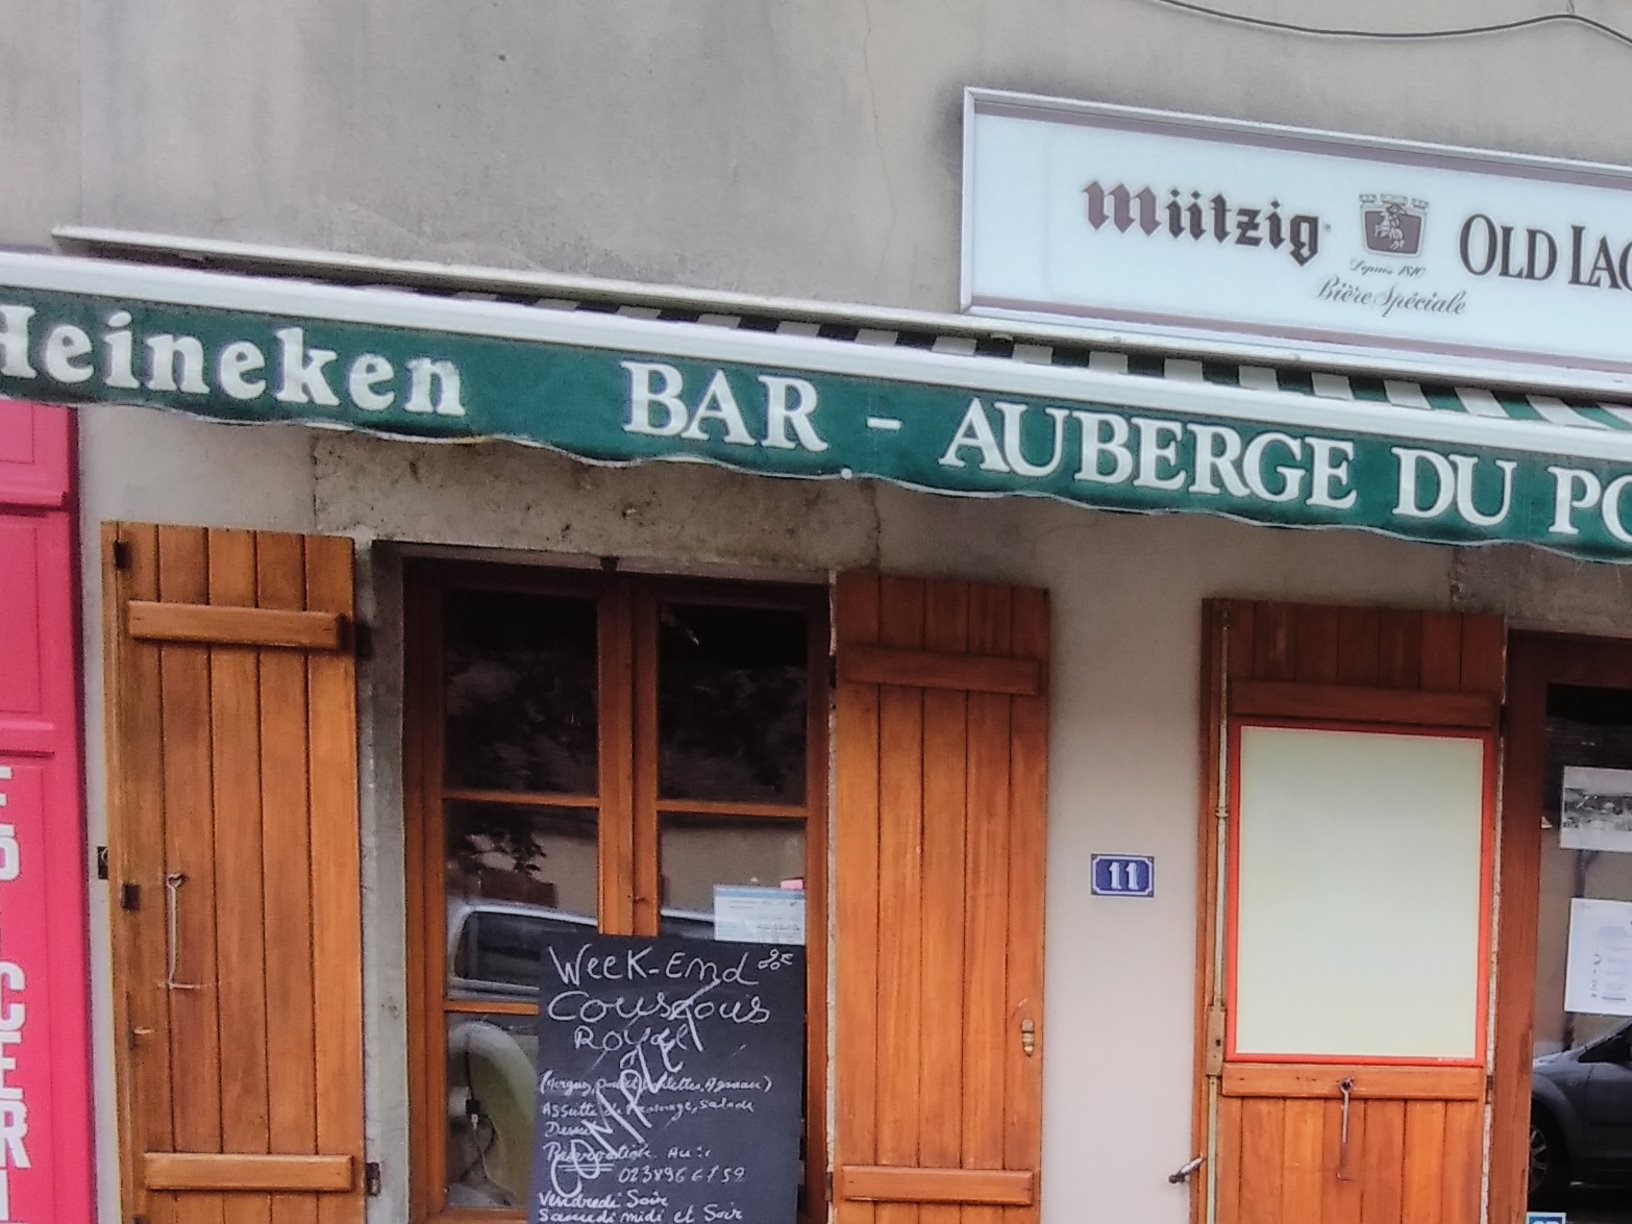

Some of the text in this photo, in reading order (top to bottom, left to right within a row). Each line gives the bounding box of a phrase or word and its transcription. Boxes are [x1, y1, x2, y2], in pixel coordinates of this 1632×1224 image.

[1458, 213, 1558, 283] OLD
[1317, 275, 1467, 318] Bière Spéciale
[0, 304, 466, 417] Heineken
[620, 359, 828, 453] BAR
[938, 397, 1358, 509] AUBERGE
[1391, 445, 1517, 527] DU
[1109, 862, 1139, 889] 11
